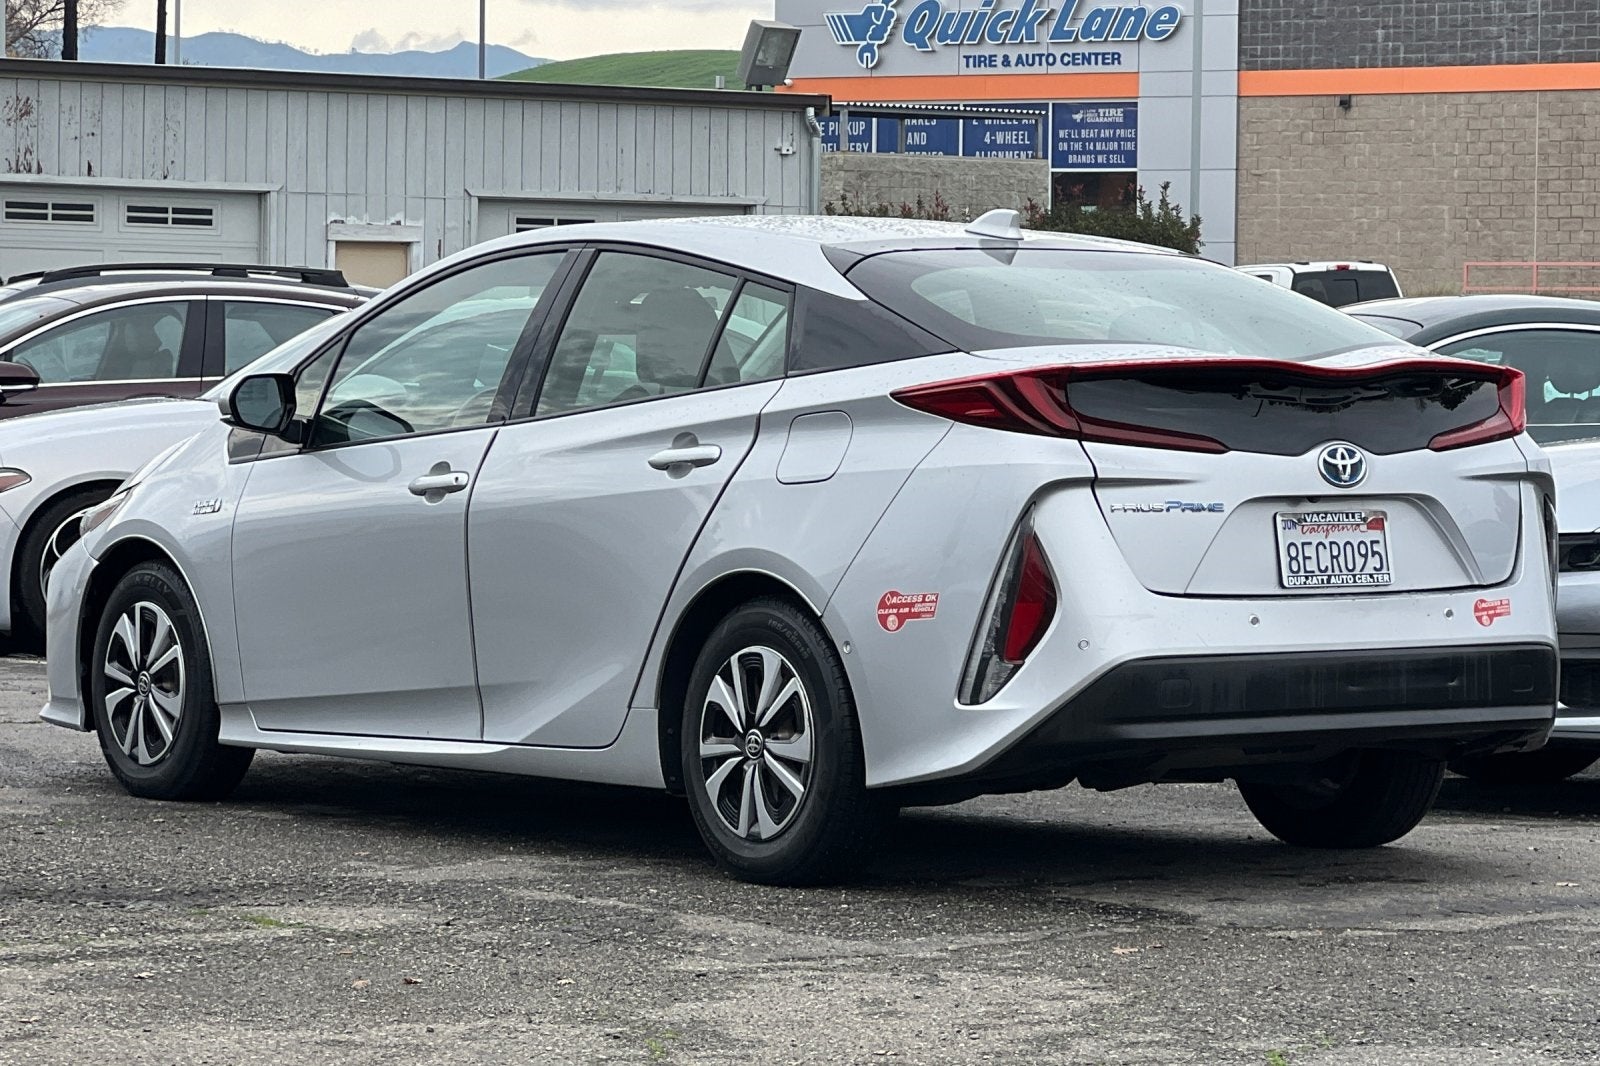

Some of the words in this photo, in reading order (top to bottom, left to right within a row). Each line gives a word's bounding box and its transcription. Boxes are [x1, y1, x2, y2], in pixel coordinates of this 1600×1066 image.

[902, 0, 1052, 51] Quick
[1047, 0, 1181, 42] Lane
[963, 55, 997, 68] TIRE
[1001, 53, 1012, 67] &
[1014, 53, 1057, 67] AUTO
[1060, 52, 1121, 66] CENTER
[1098, 108, 1124, 117] TIRE
[828, 121, 866, 136] PIKUP
[1058, 129, 1079, 138] WE'LL
[1081, 129, 1099, 138] BEAT
[1100, 129, 1115, 138] ANY
[1115, 128, 1136, 138] PRICE
[906, 132, 927, 145] AND
[984, 131, 1031, 145] 4-WHEEL
[1058, 142, 1068, 151] ON
[1070, 142, 1083, 151] THE
[1085, 142, 1094, 151] 14
[1095, 142, 1119, 151] MAJOR
[1120, 141, 1136, 150] TIRE
[1068, 154, 1095, 164] BRANDS
[1096, 154, 1108, 163] WE
[1109, 154, 1126, 163] SELL
[1305, 513, 1362, 523] VACAVILLE
[1282, 520, 1298, 531] JUN
[1286, 540, 1385, 575] 8ECR095
[1330, 575, 1354, 585] AUTO
[1355, 574, 1391, 584] CENTER
[891, 595, 923, 604] ACCESS
[925, 593, 938, 602] OK
